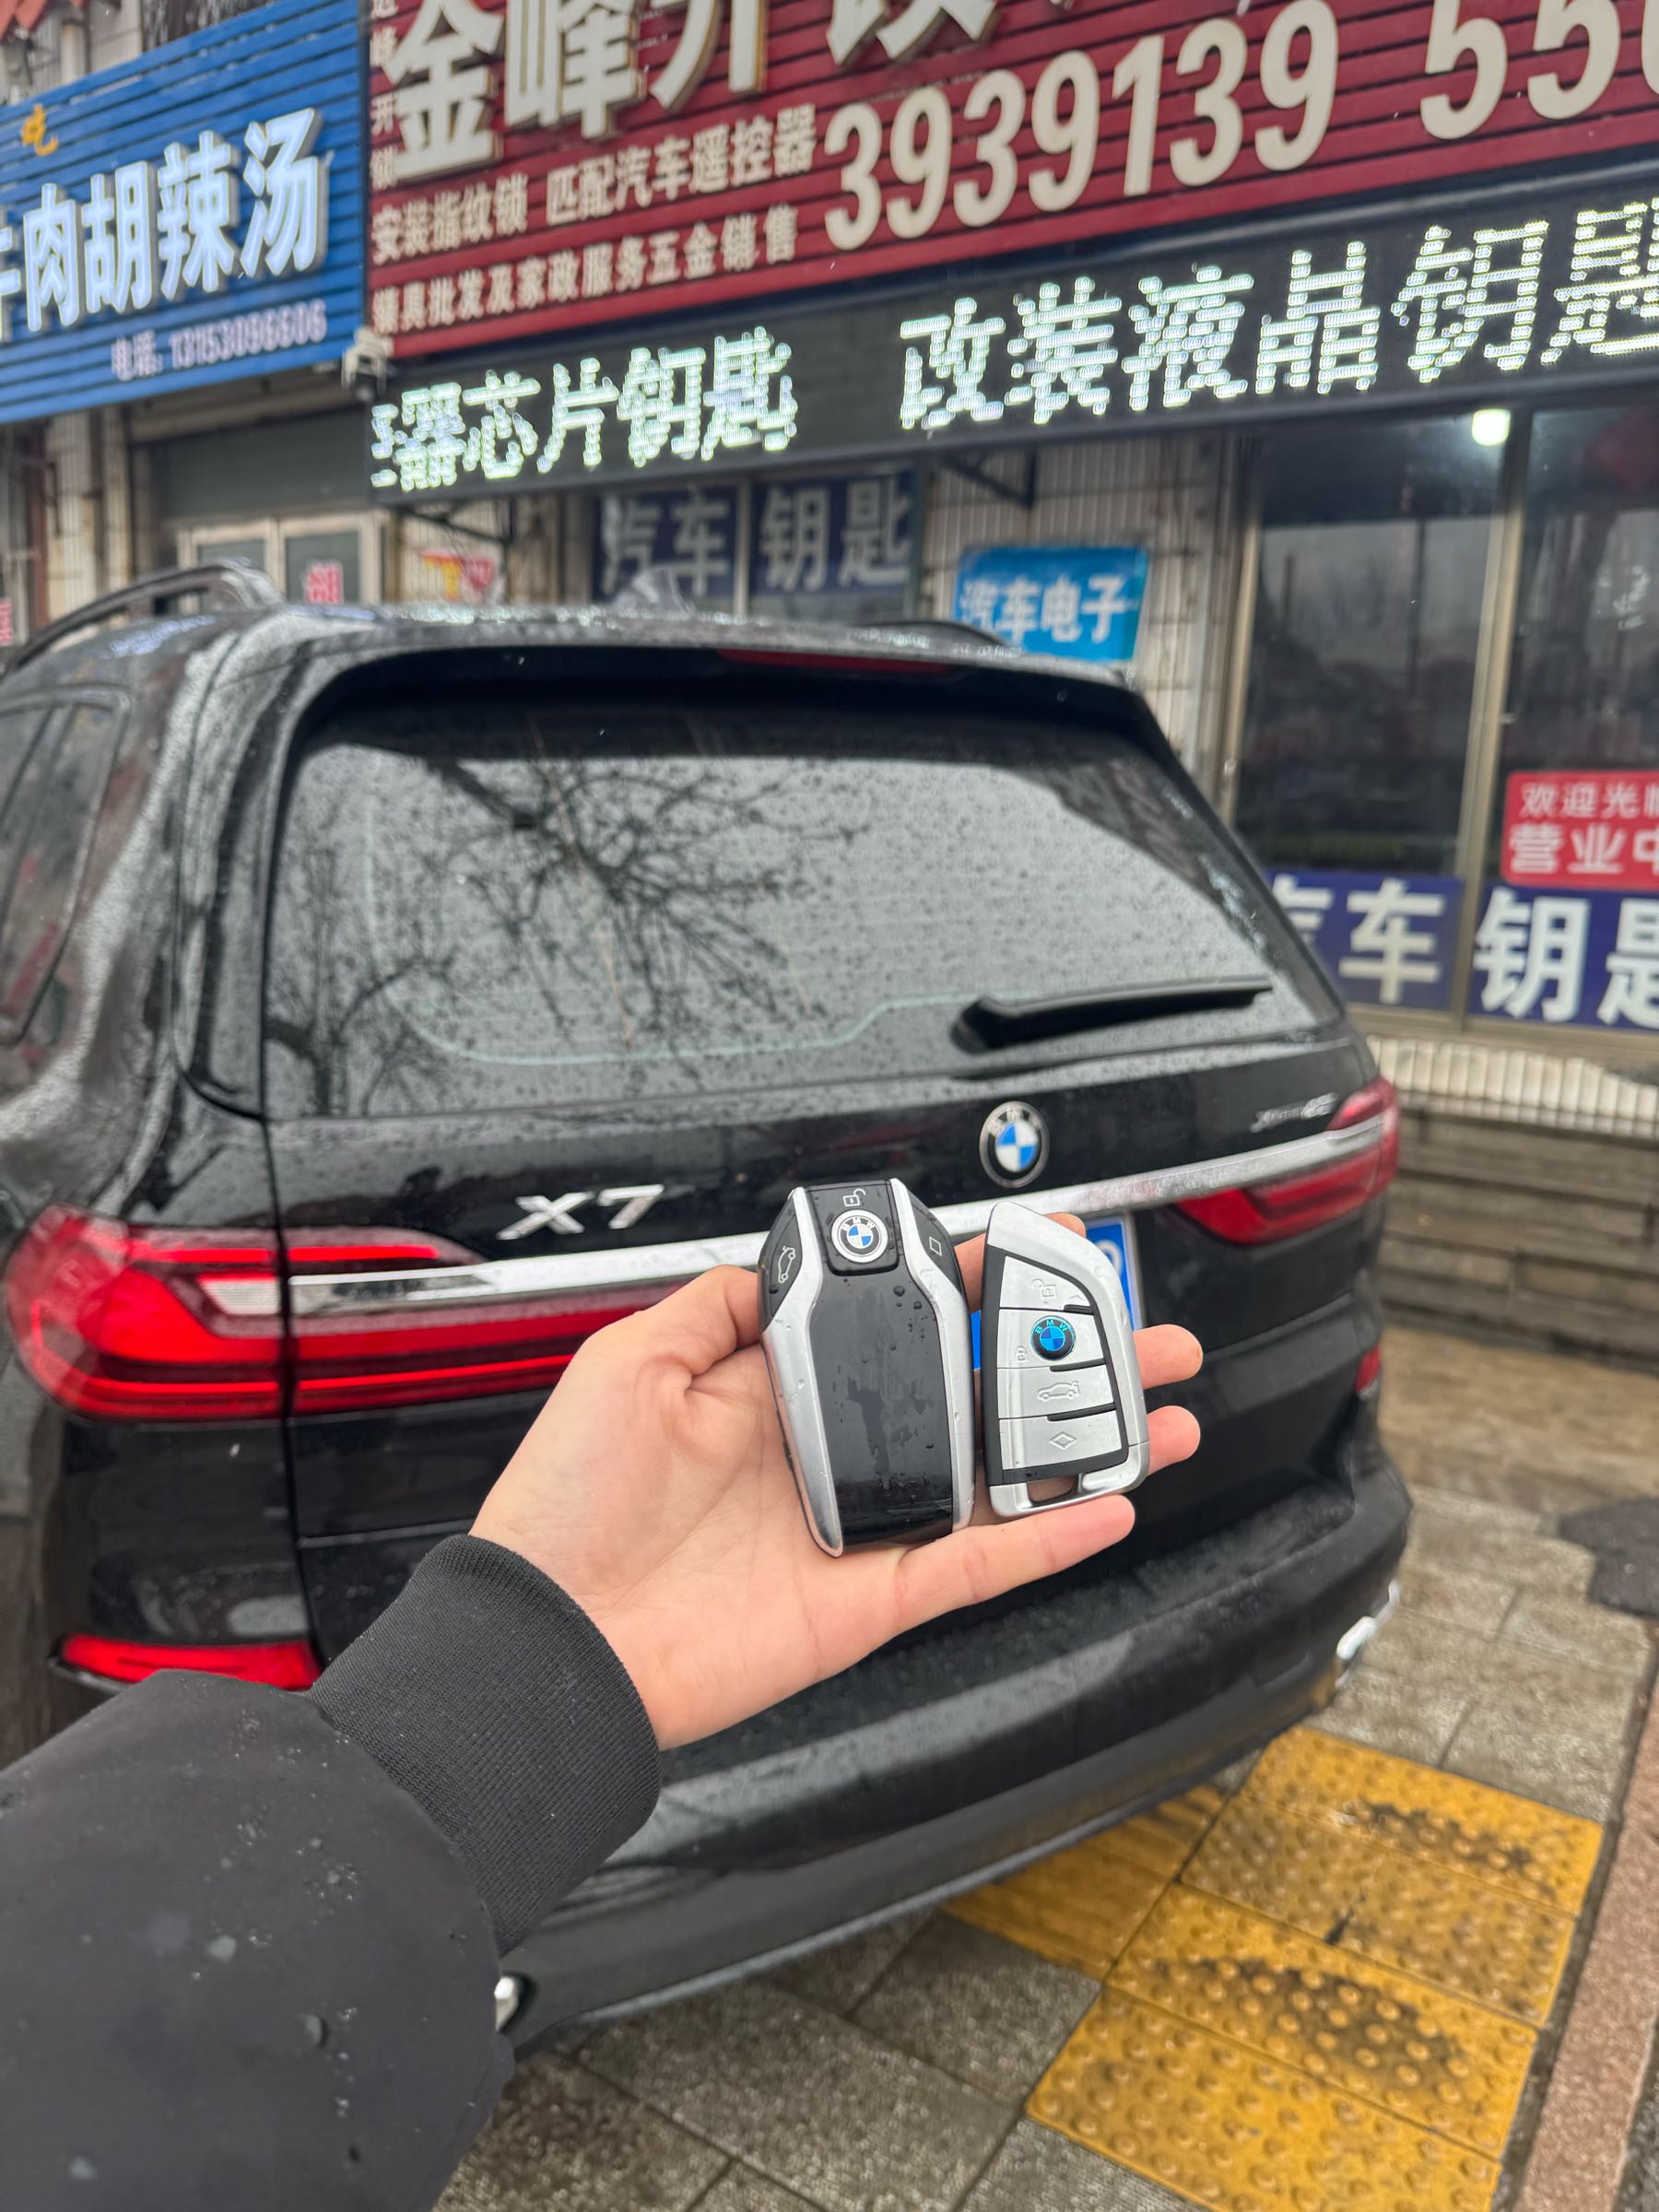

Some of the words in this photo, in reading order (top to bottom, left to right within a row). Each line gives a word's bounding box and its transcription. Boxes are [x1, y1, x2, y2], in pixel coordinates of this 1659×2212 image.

[546, 102, 817, 226] 匹配汽车遥控器
[825, 0, 1338, 250] 3939139
[1420, 0, 1659, 140] 55
[759, 477, 914, 594] 钥匙
[959, 573, 1130, 645] 汽车电子
[496, 1183, 665, 1241] X7
[1034, 1319, 1069, 1335] BMW
